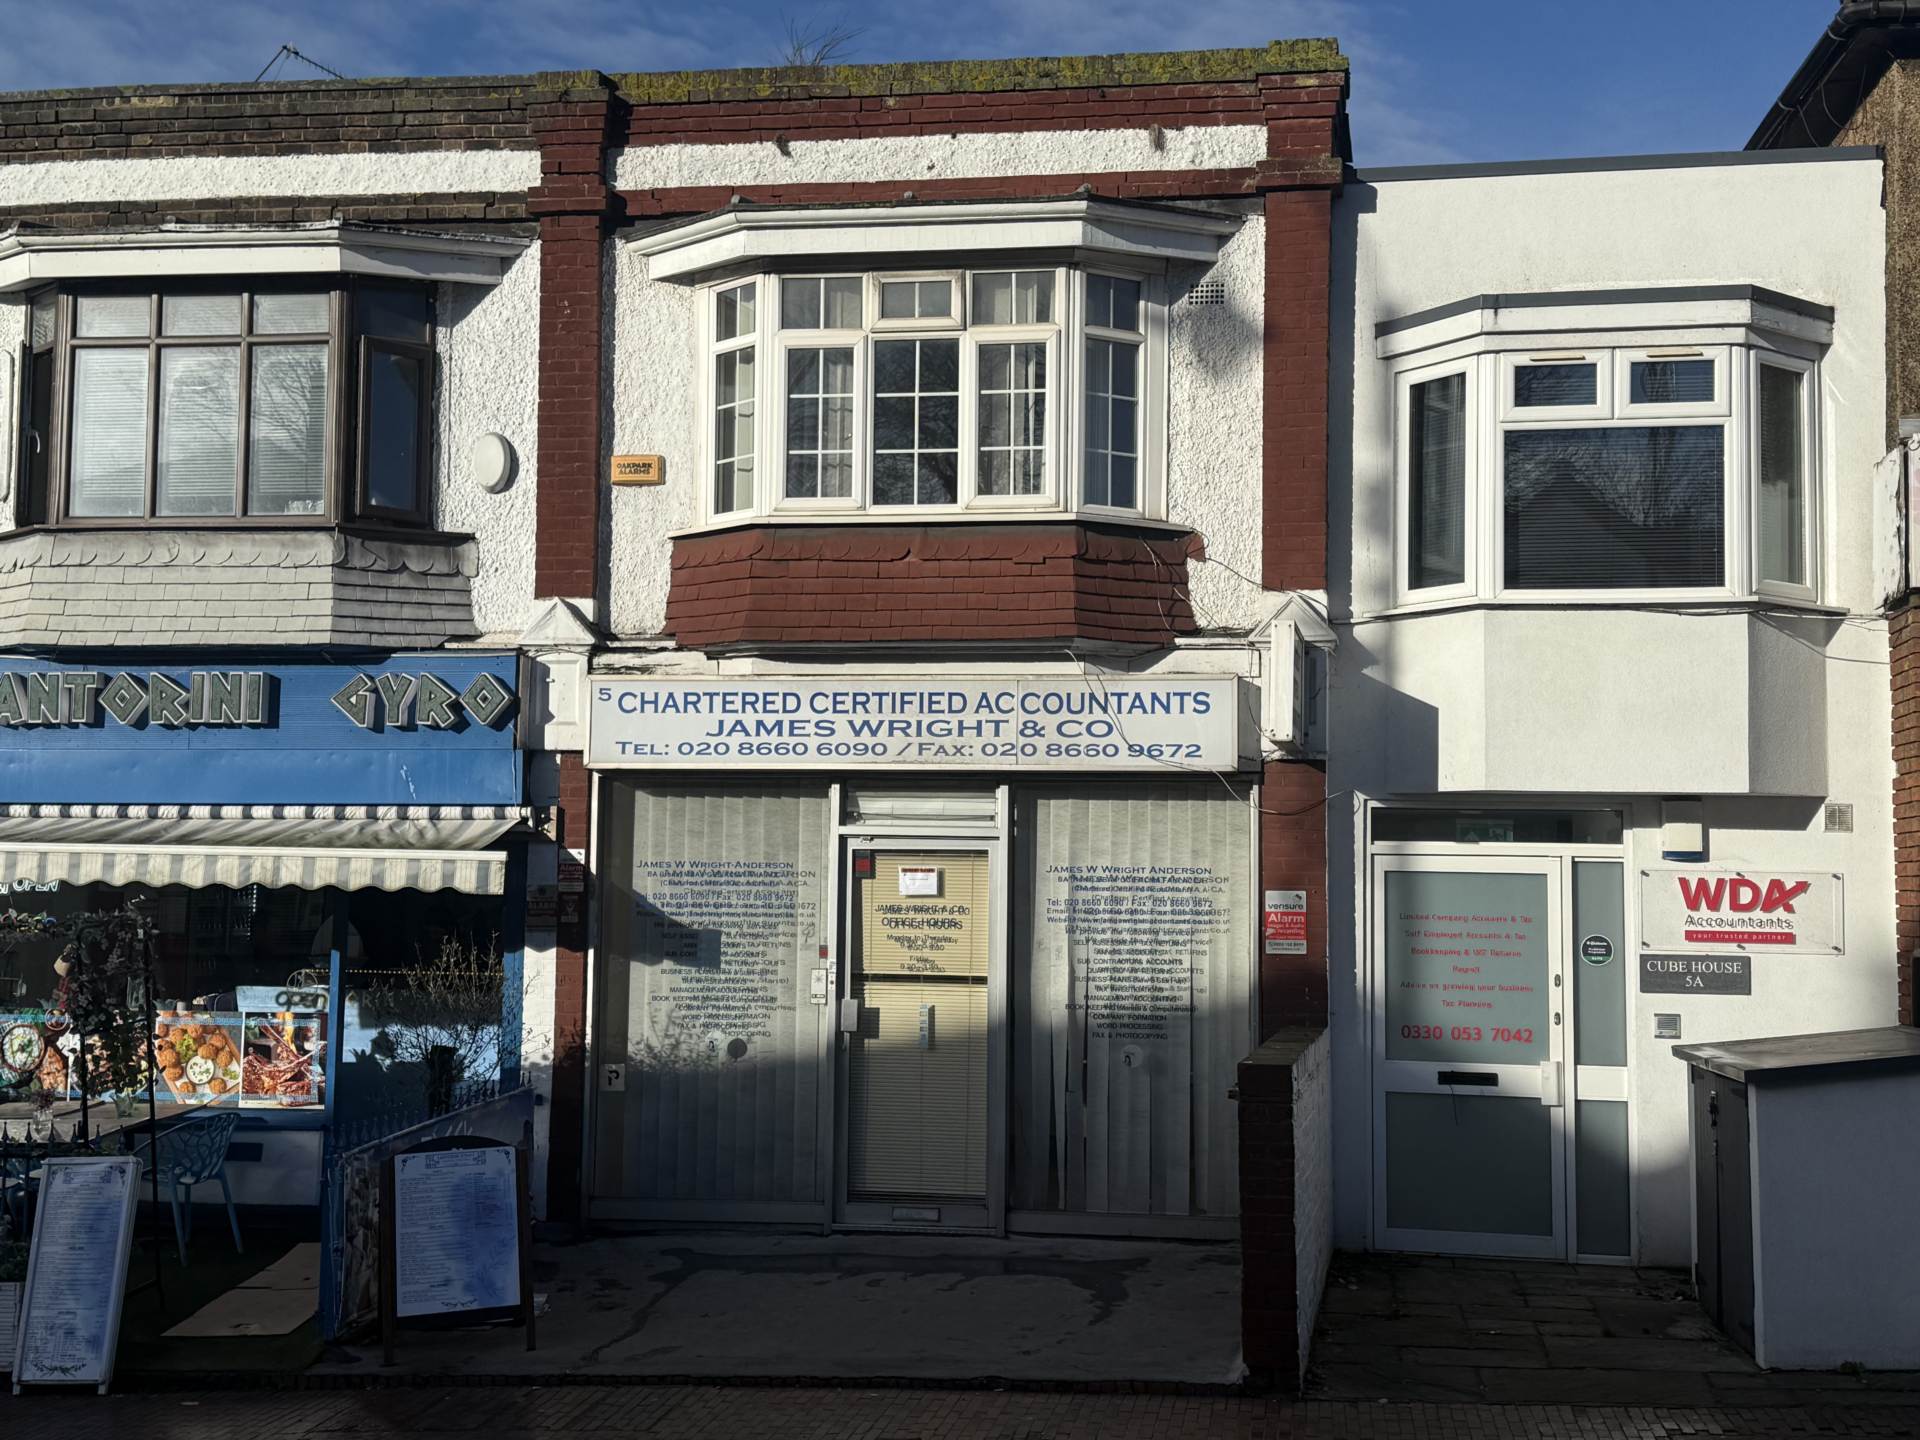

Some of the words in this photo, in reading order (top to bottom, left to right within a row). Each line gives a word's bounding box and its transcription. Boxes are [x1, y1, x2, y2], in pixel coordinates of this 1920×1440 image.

[330, 672, 514, 728] GYRO
[598, 688, 612, 702] 5
[617, 691, 803, 715] CHARTERED
[808, 691, 969, 715] CERTIFIED
[974, 691, 1212, 716] ACCOUNTANTS
[705, 719, 836, 738] JAMES
[846, 719, 1011, 738] WRIGHT
[1017, 719, 1046, 738] &
[1055, 719, 1115, 738] CO
[677, 741, 731, 757] 020
[737, 741, 811, 757] 8660
[816, 741, 889, 757] 6090
[895, 741, 912, 757] /
[981, 742, 1039, 757] 020
[1045, 742, 1120, 757] 8660
[1127, 743, 1203, 758] 9672
[674, 860, 687, 869] W
[1087, 865, 1098, 873] W
[1677, 877, 1812, 914] WDA
[1268, 913, 1304, 923] Alarm
[1684, 914, 1794, 930] Accountants
[1647, 961, 1688, 973] CUBE
[1691, 962, 1743, 974] HOUSE
[1685, 976, 1704, 987] 5A
[1401, 1025, 1443, 1040] 0330
[1451, 1026, 1482, 1041] 053
[1491, 1027, 1533, 1043] 7042
